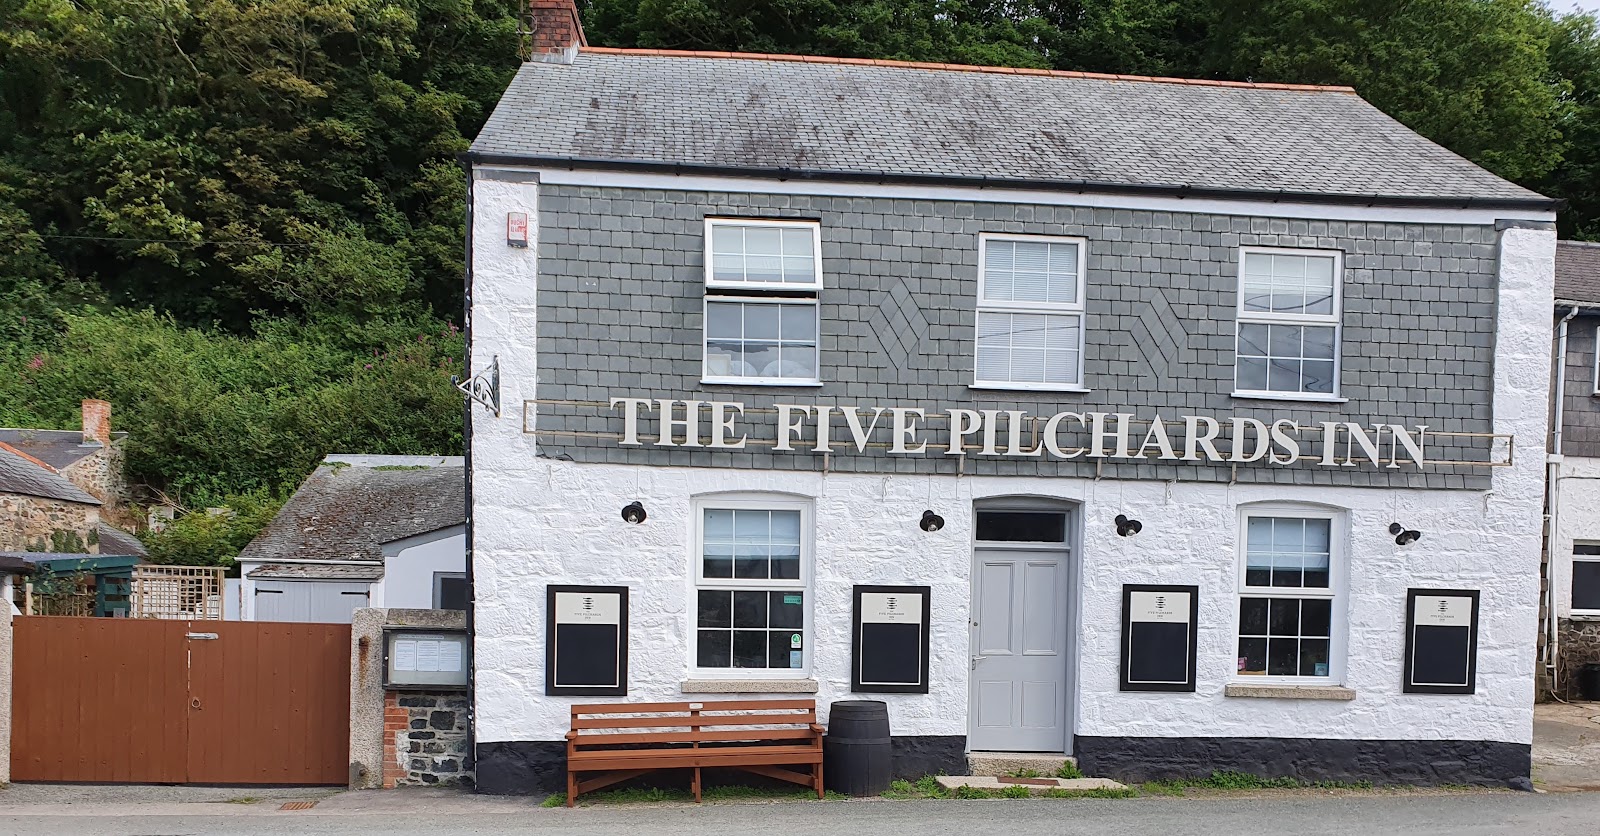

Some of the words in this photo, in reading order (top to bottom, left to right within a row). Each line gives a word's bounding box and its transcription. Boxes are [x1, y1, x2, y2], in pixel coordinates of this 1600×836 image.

[610, 397, 747, 449] THE
[771, 404, 927, 454] FIVE
[944, 408, 1300, 466] PILCHARDS
[1317, 421, 1429, 470] INN
